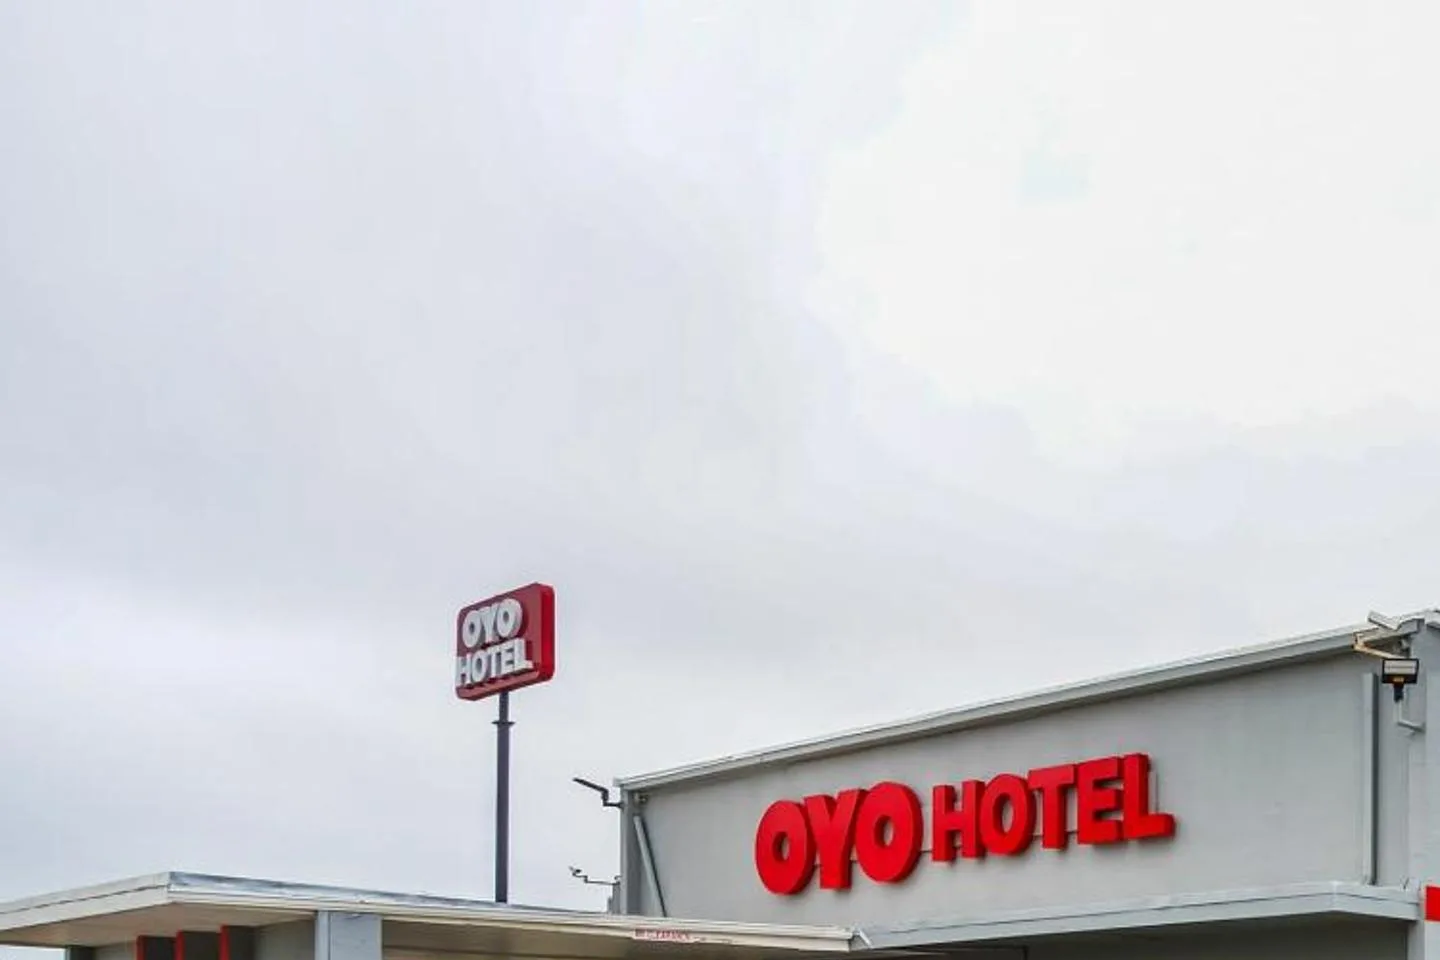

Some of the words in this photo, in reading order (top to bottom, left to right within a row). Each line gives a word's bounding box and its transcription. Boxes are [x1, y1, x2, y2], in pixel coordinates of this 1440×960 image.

[462, 598, 522, 648] OYO
[455, 638, 533, 687] HOTEL
[755, 782, 924, 894] OYO
[932, 753, 1176, 862] HOTEL
